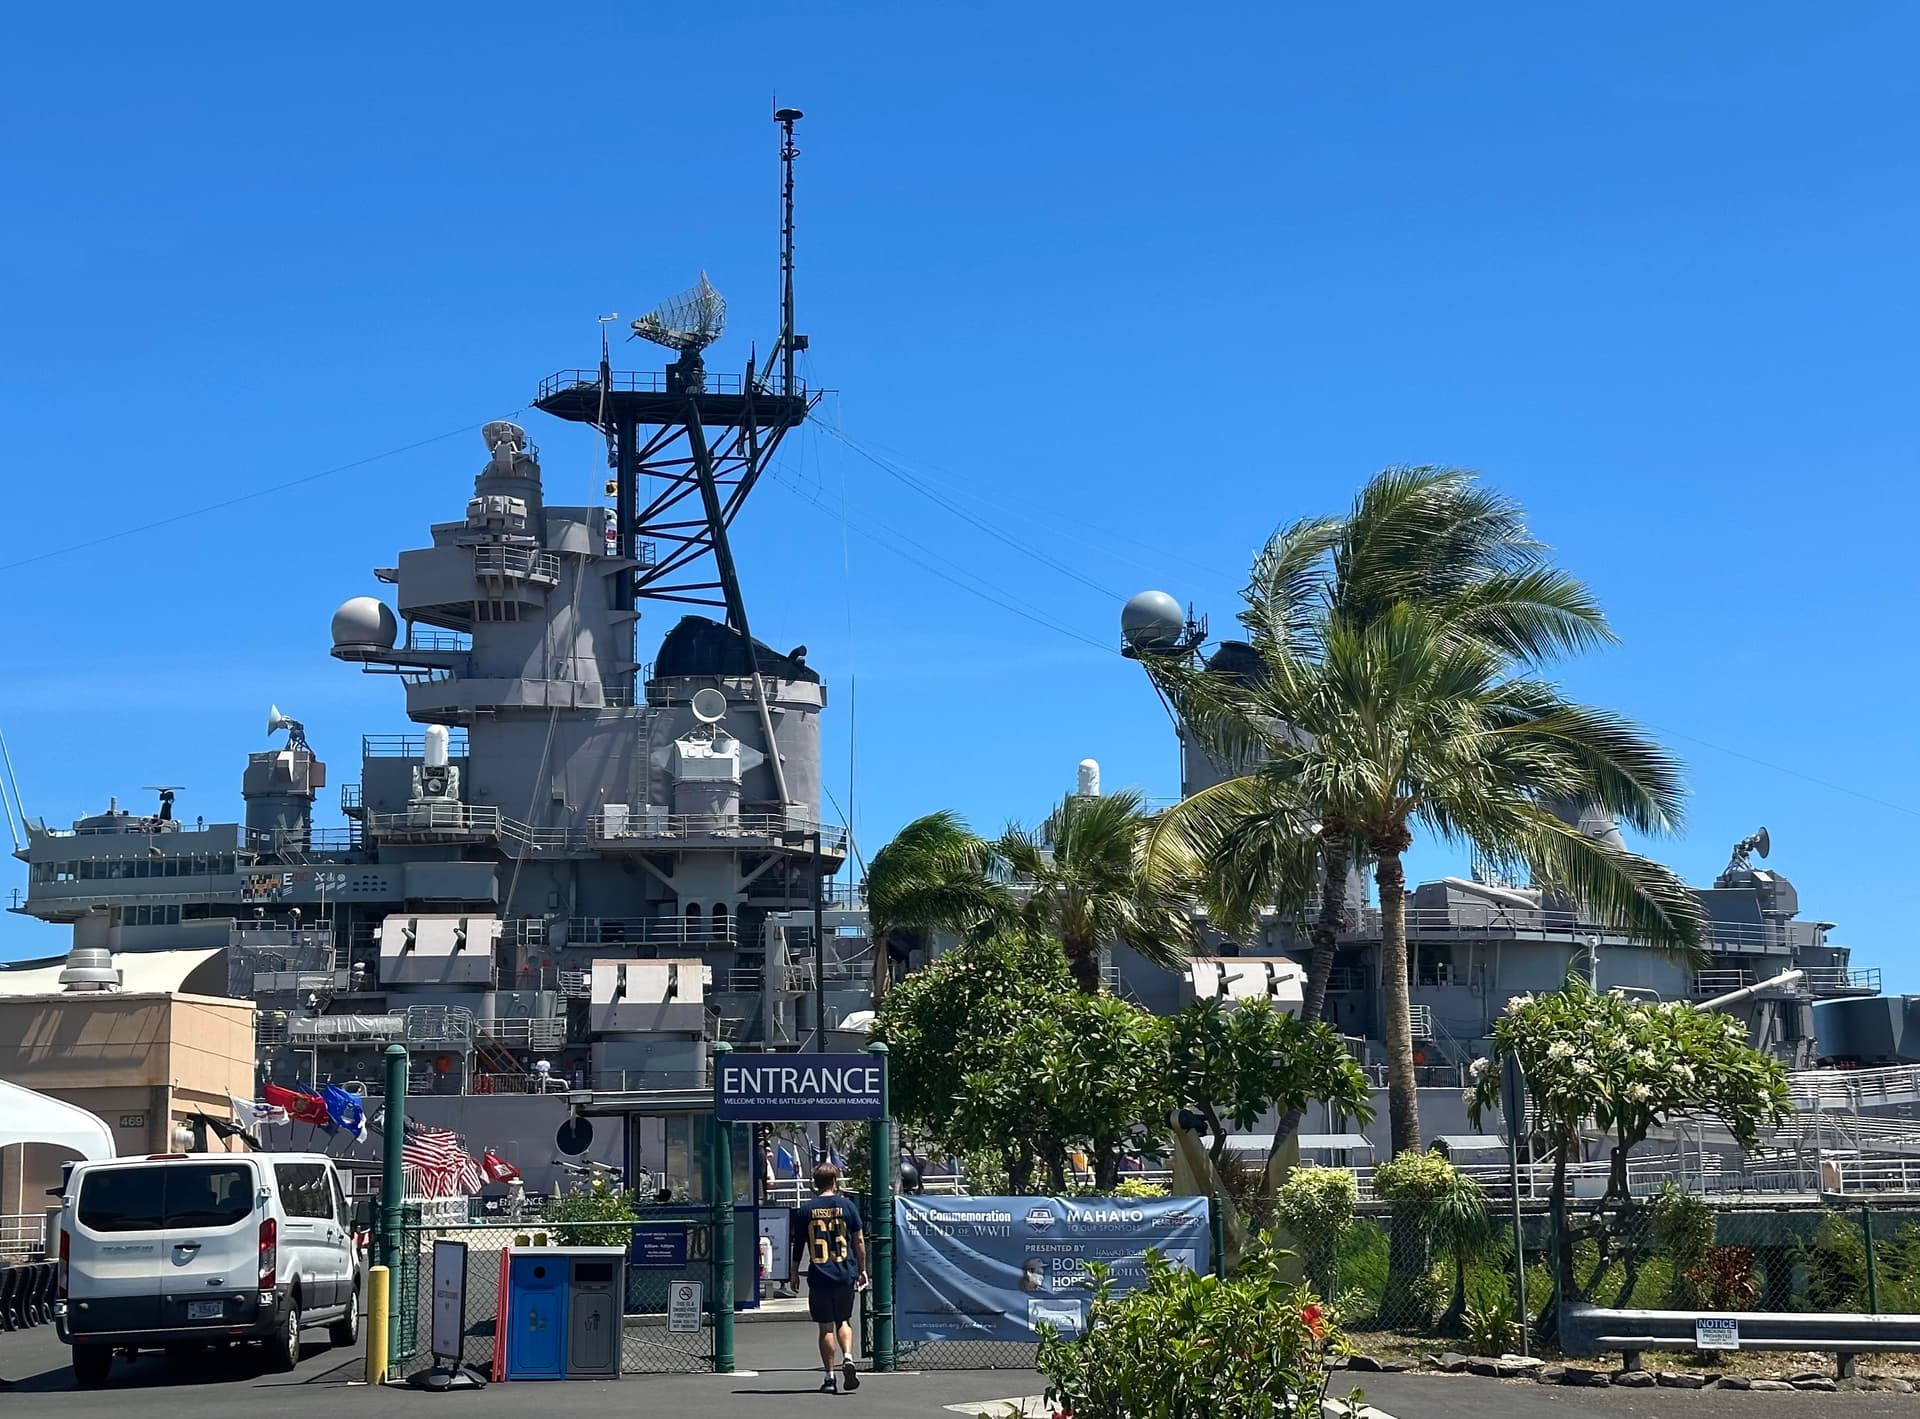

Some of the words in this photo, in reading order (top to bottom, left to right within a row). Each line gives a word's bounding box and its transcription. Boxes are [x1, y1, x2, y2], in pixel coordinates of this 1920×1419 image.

[723, 1067, 880, 1094] ENTRANCE
[724, 1097, 755, 1105] WELCOME
[756, 1097, 764, 1105] TO
[765, 1097, 778, 1105] THE
[779, 1097, 815, 1105] BATTLESHIP
[816, 1097, 846, 1105] MISSOURI
[847, 1097, 880, 1105] MEMORIAL
[929, 1209, 1011, 1223] Commemoration
[1066, 1209, 1144, 1222] MAHALO
[925, 1224, 955, 1236] END
[808, 1218, 848, 1264] 63
[1025, 1244, 1072, 1252] PRESENTED
[1073, 1244, 1085, 1252] BY
[1052, 1257, 1085, 1271] BOB
[1698, 1320, 1735, 1328] NOTICE
